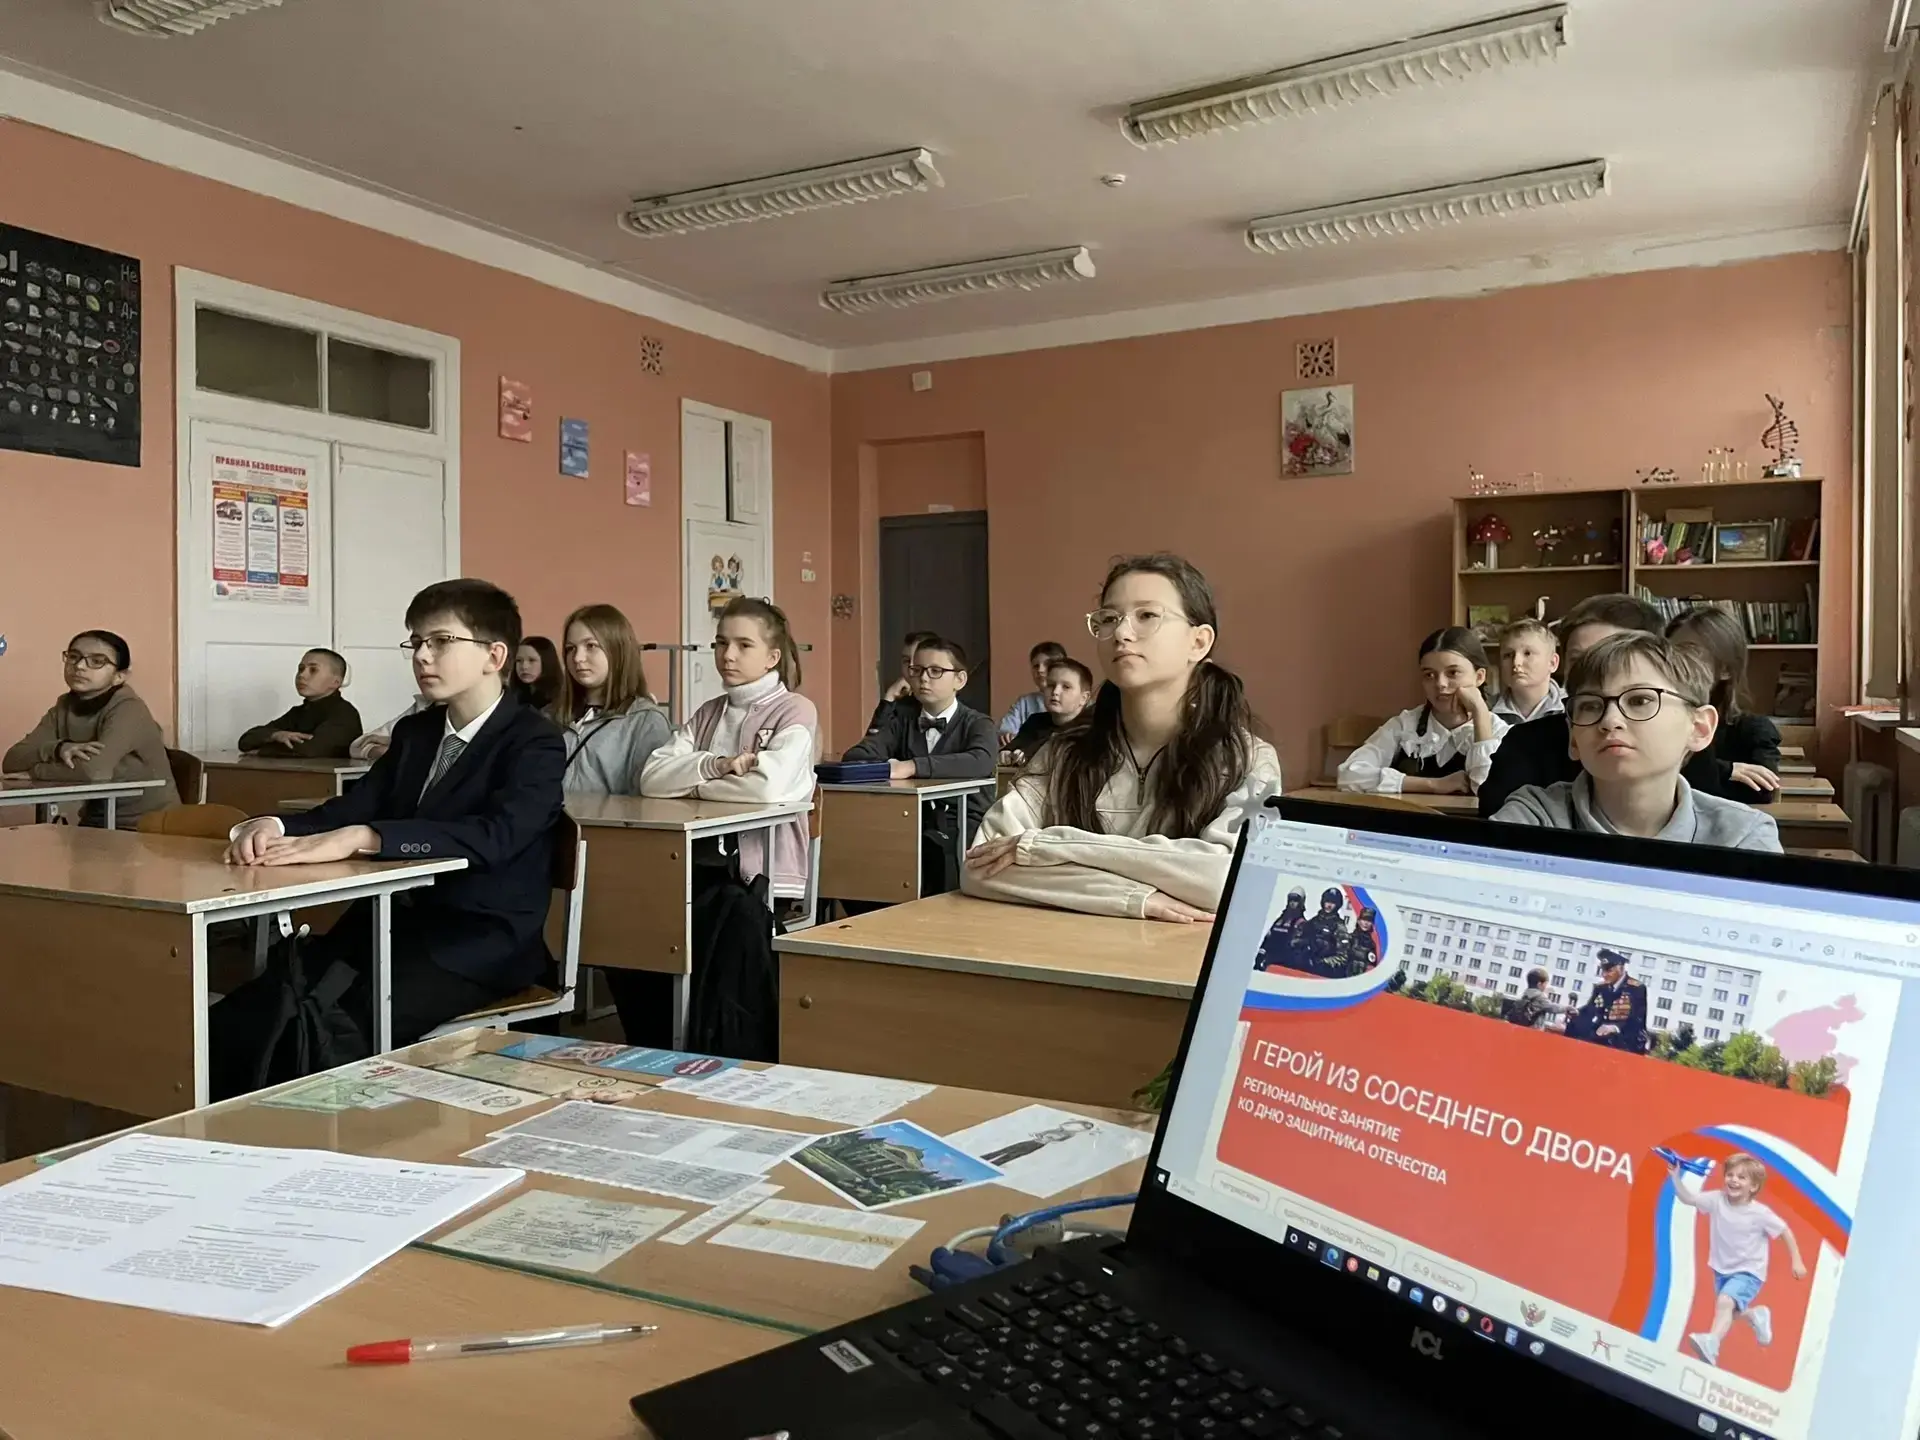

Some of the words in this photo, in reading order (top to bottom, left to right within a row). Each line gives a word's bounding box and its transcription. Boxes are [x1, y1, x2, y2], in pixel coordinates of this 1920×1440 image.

[215, 455, 251, 468] ПРАВИЛА
[252, 461, 306, 476] БЕЗОПАСНОСТИ
[1238, 1097, 1254, 1113] КО
[1253, 1103, 1285, 1124] ДНЮ
[1285, 1114, 1366, 1155] ЗАЩИТНИКА
[1368, 1144, 1447, 1184] ОТЕЧЕСТВА
[1243, 1076, 1339, 1121] РЕГИОНАЛЬНОЕ
[1338, 1109, 1402, 1143] ЗАНЯТИЕ
[1252, 1039, 1324, 1082] ГЕРОЙ
[1326, 1062, 1360, 1094] ИЗ
[1364, 1075, 1524, 1146] СОСЕДНЕГО
[1525, 1126, 1633, 1184] ДВОРА
[1410, 1325, 1443, 1361] ICL
